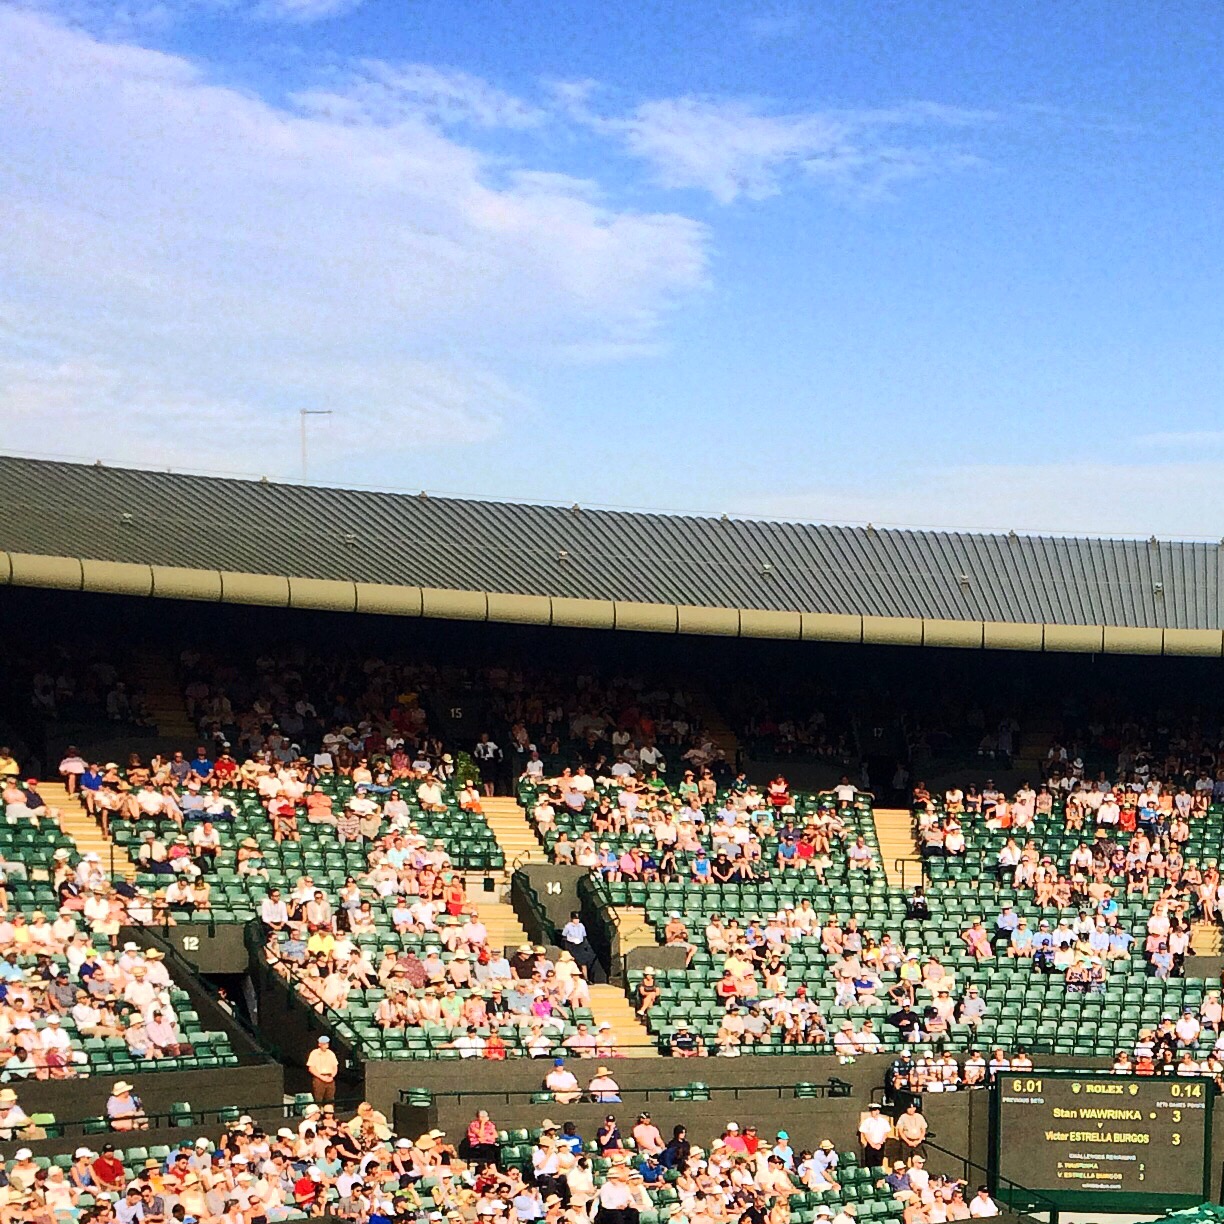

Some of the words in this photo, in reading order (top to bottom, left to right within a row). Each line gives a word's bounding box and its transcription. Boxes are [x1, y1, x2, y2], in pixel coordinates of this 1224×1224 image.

[450, 707, 462, 719] 15
[547, 881, 561, 895] 14
[182, 936, 199, 951] 12
[1013, 1079, 1042, 1093] 6.01
[1085, 1084, 1124, 1094] ROLEX
[1171, 1084, 1201, 1098] 0.14
[1053, 1108, 1077, 1119] Stan
[1079, 1108, 1142, 1121] WAWRINKA
[1172, 1110, 1181, 1123] 3
[1069, 1131, 1112, 1143] ESTRELLA
[1113, 1132, 1150, 1144] BURGOS
[1171, 1133, 1181, 1146] 3
